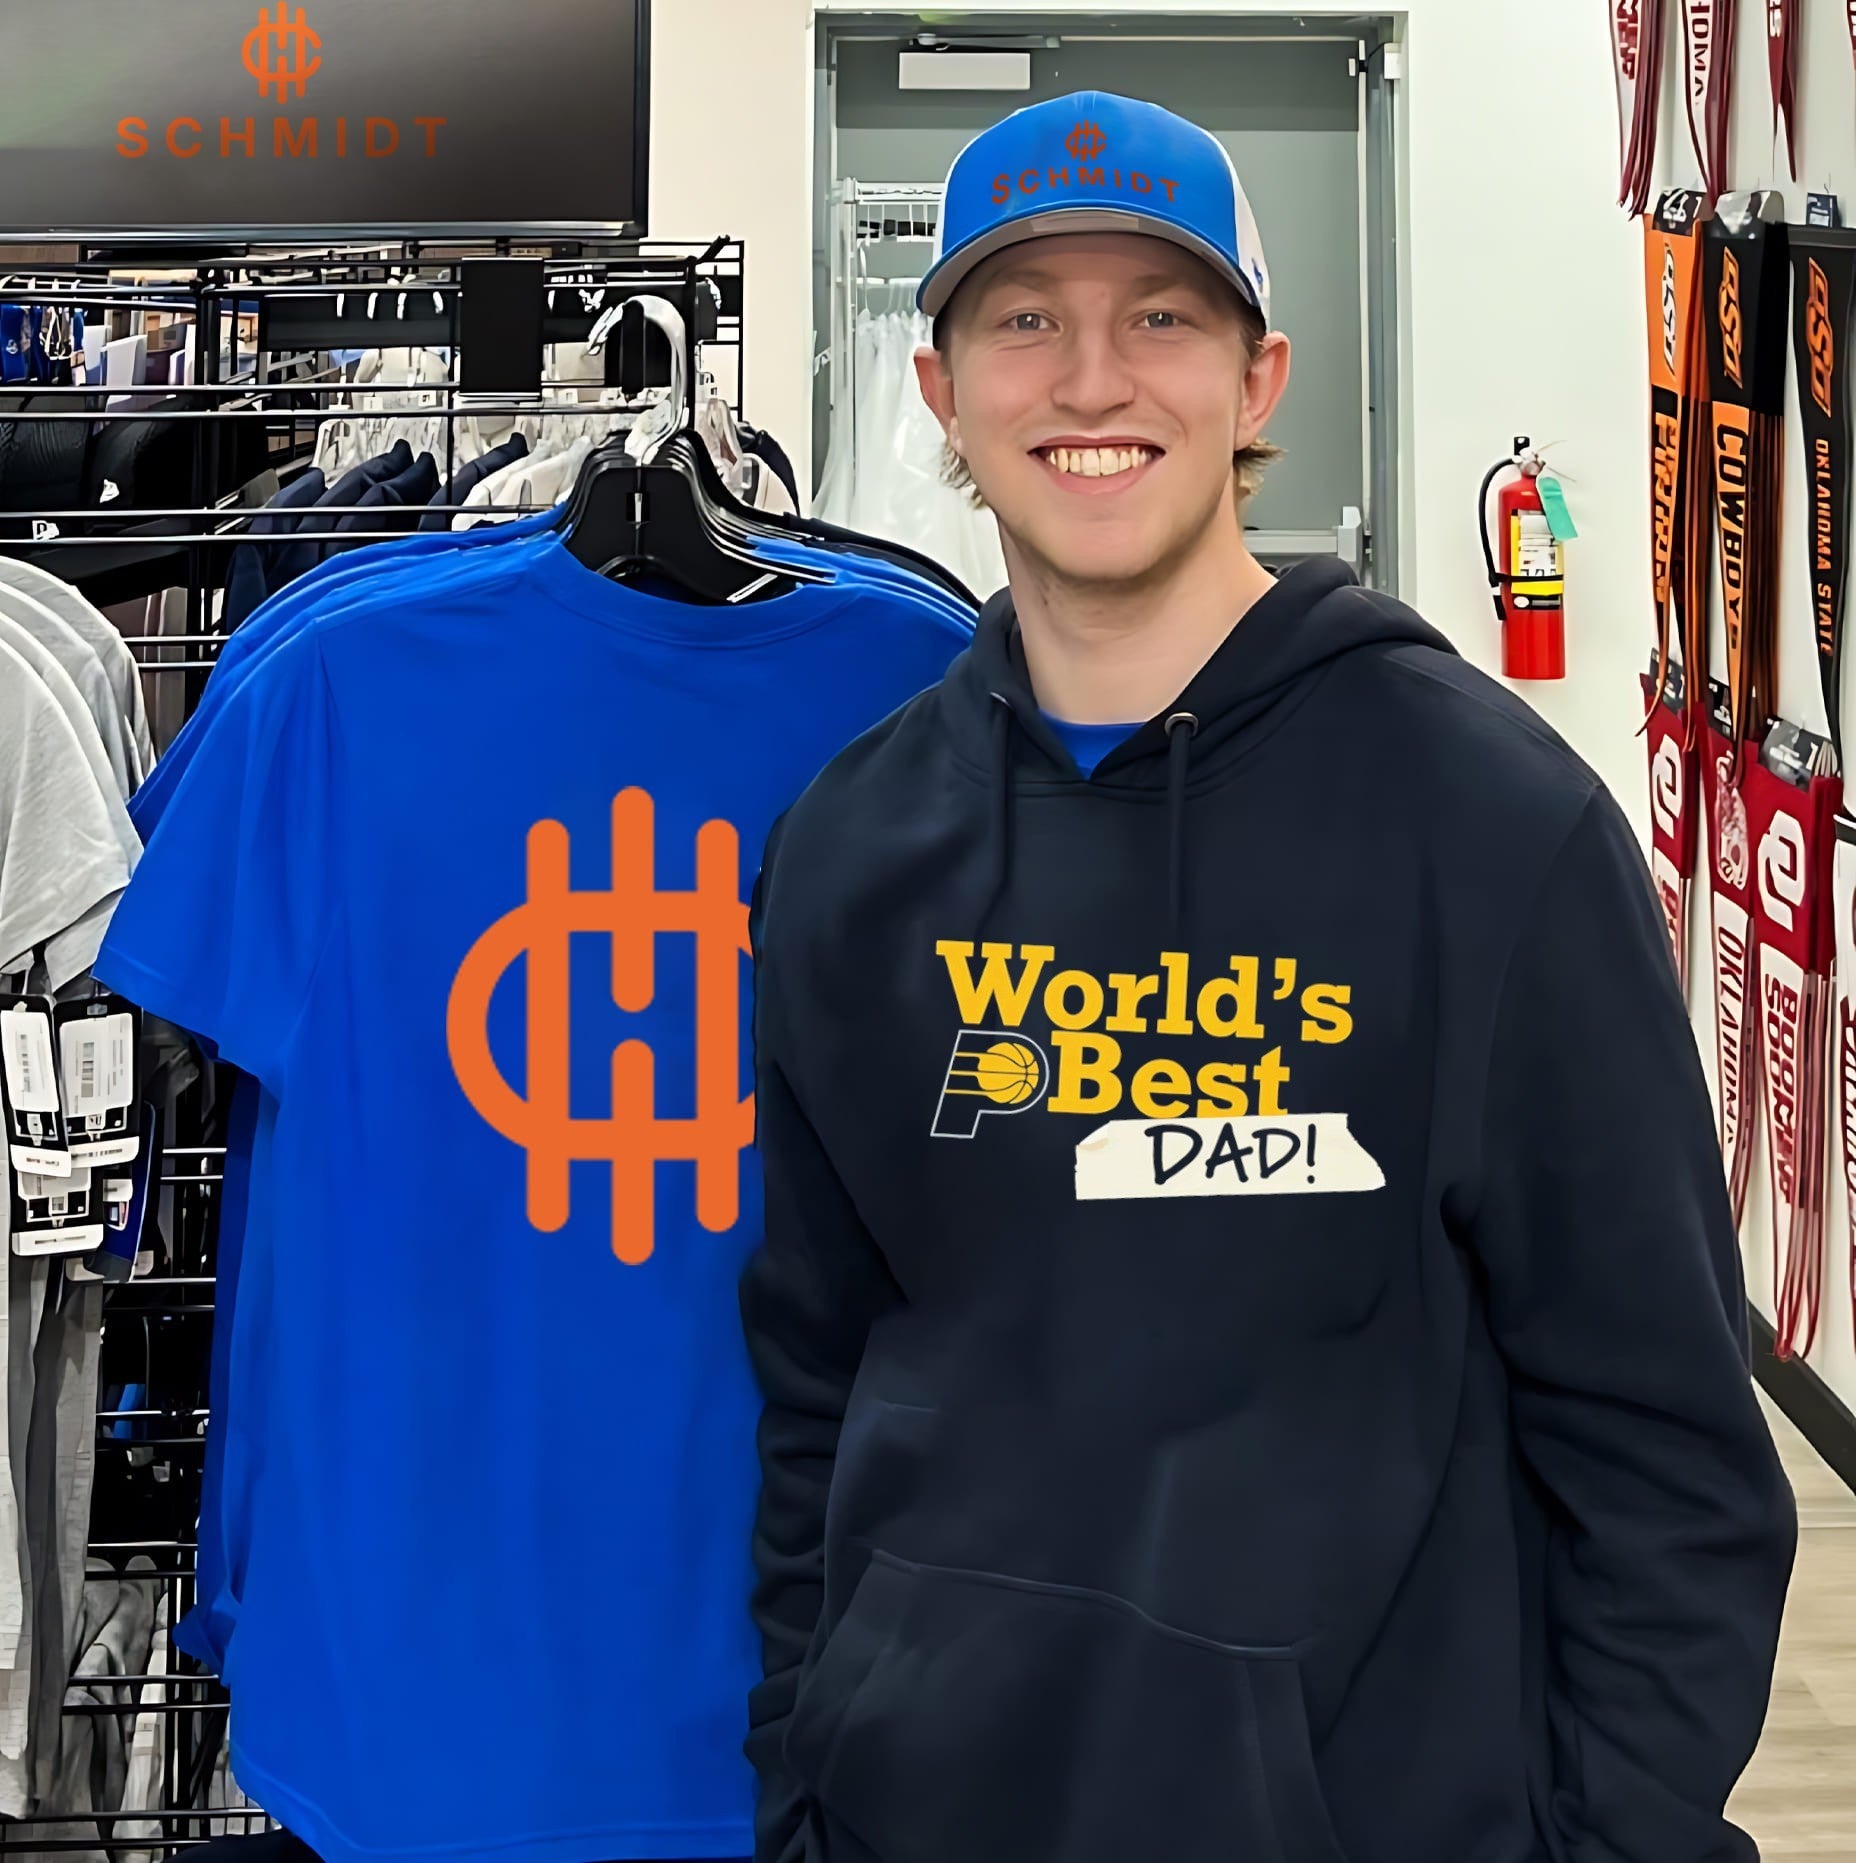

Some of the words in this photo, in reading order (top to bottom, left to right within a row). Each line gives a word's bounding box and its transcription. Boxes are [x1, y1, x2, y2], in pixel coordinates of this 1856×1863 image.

[115, 116, 448, 159] SCHMIDT
[991, 166, 1179, 204] SCHMIDT
[1815, 438, 1832, 570] OKLAHOMA
[935, 939, 1354, 1045] World's
[1717, 925, 1745, 1144] OKLAHOMA
[1047, 1030, 1291, 1119] Best
[1144, 1122, 1316, 1185] DAD!
